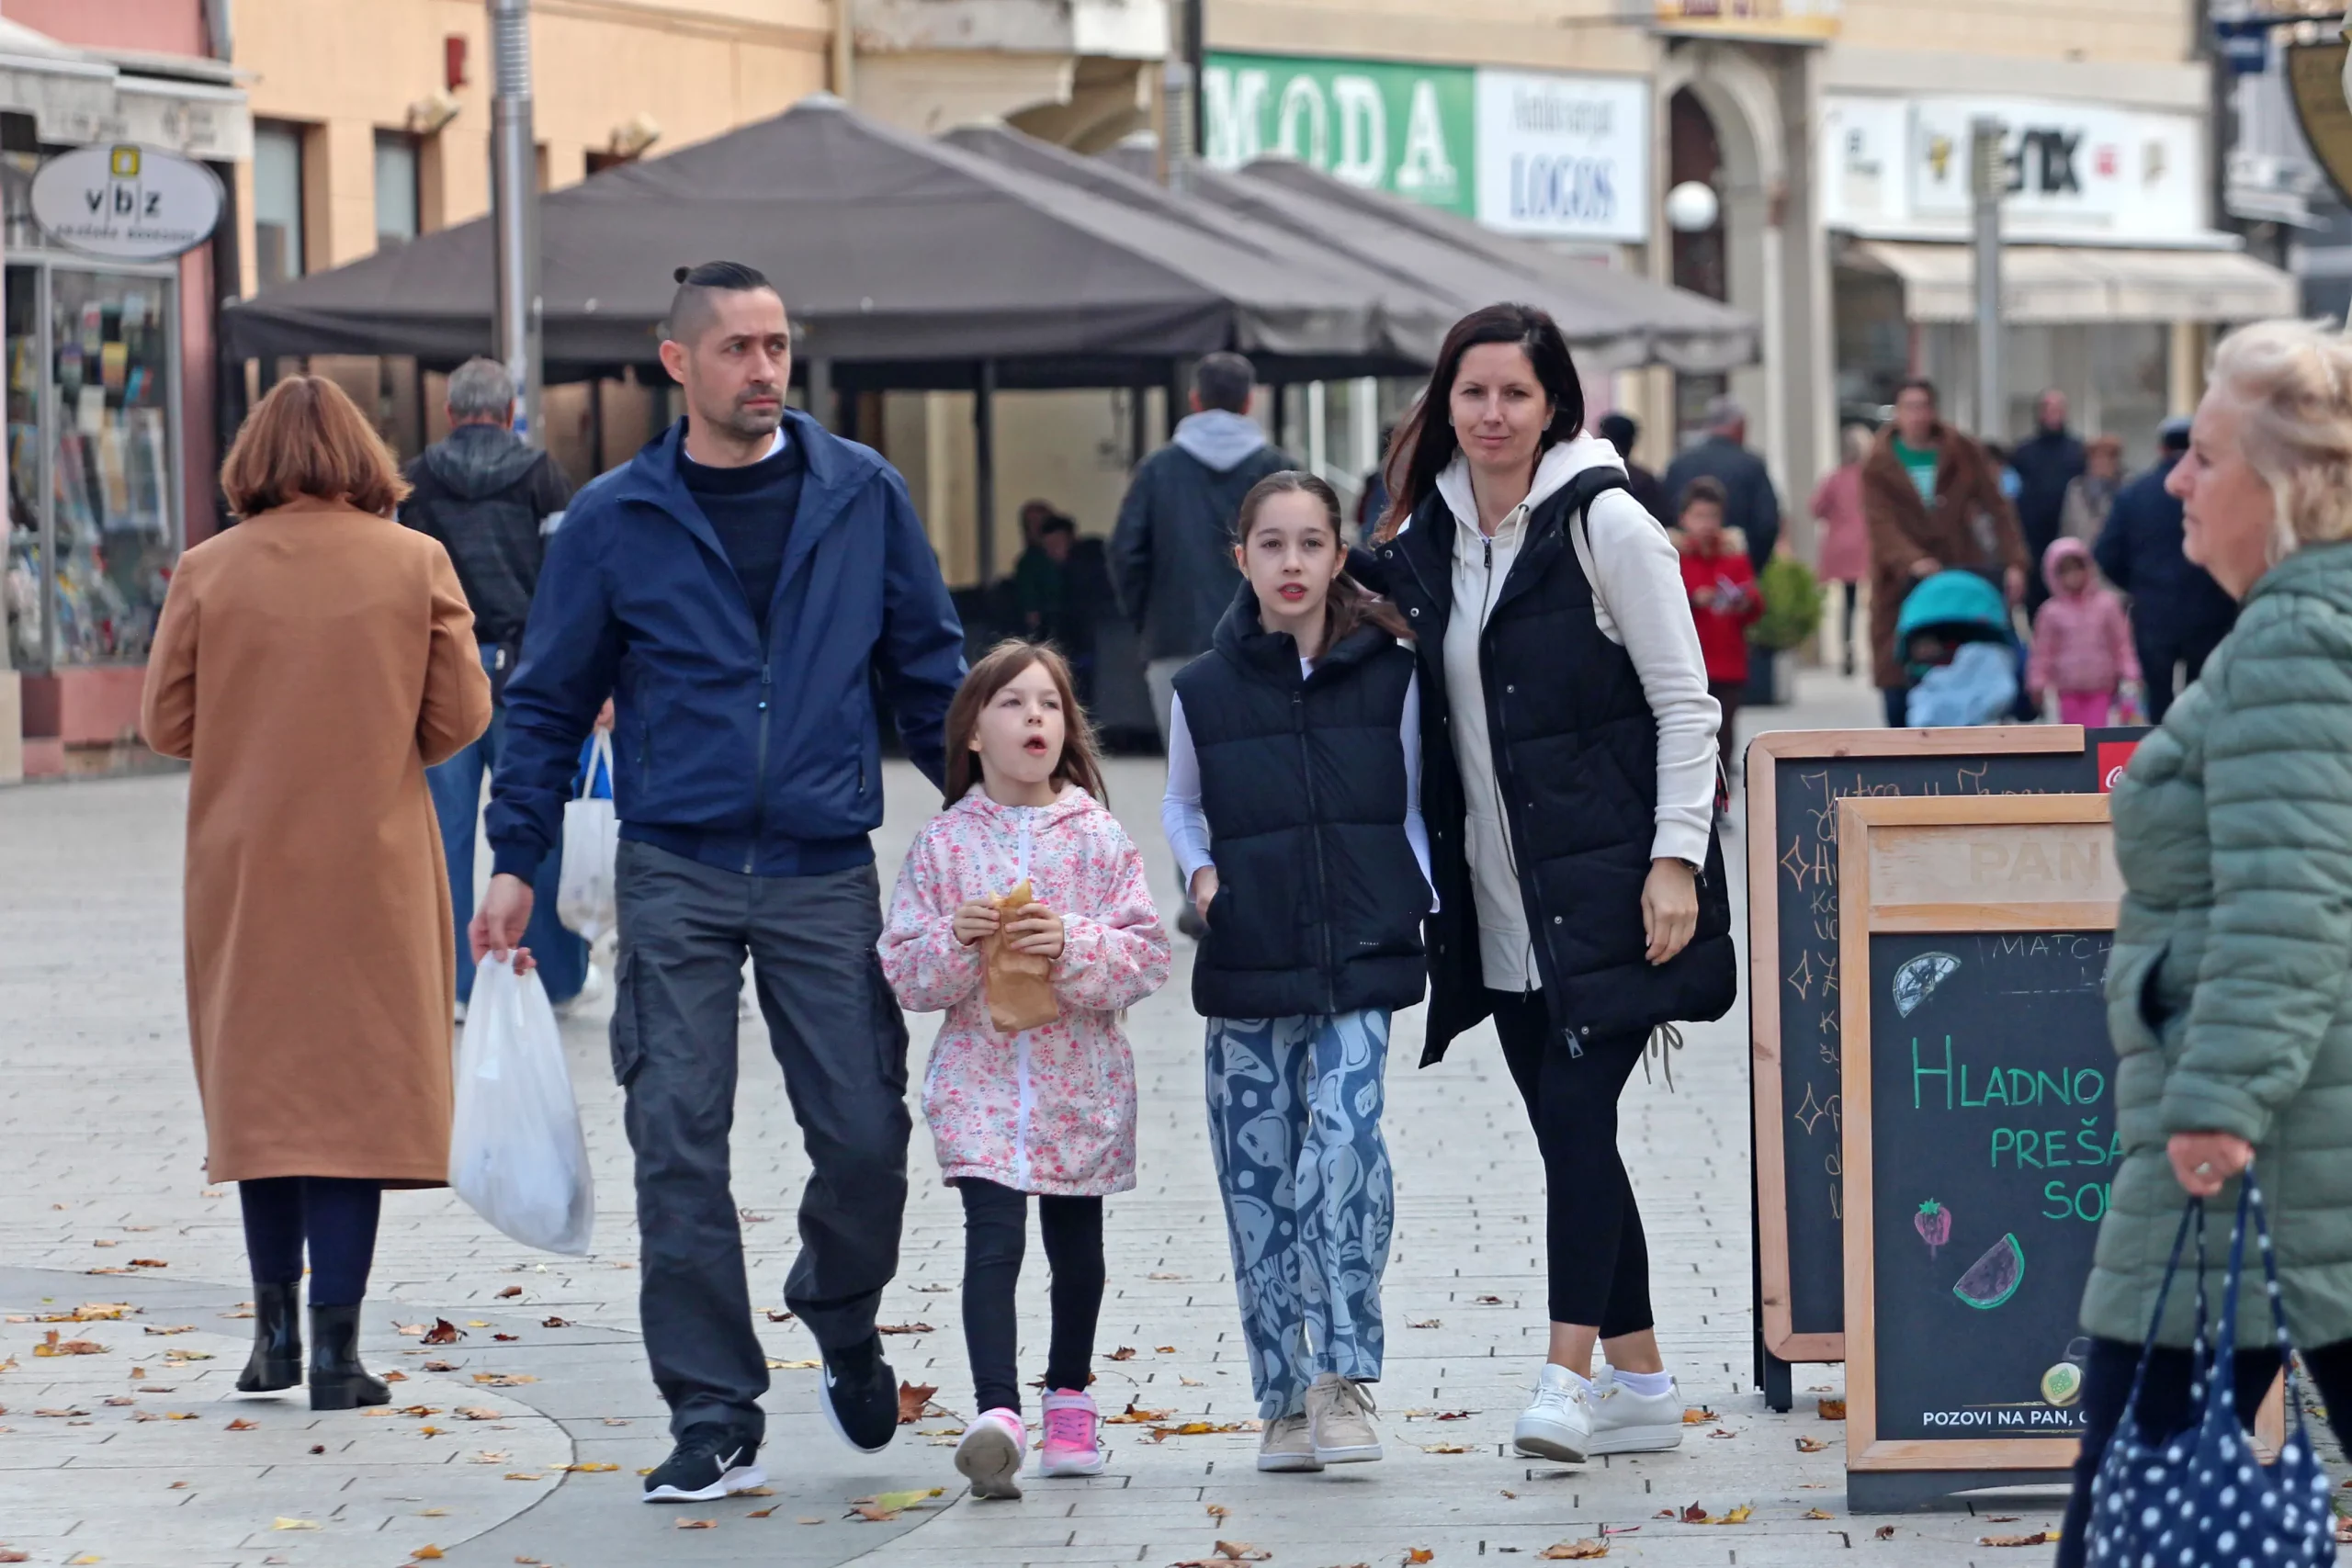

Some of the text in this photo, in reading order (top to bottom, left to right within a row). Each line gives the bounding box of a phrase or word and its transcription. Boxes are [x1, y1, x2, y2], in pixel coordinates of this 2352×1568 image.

[1202, 67, 1457, 189] MODA
[1511, 153, 1617, 222] LOGOS
[1969, 841, 2101, 882] PAN
[1912, 1034, 2105, 1110] HLADNO
[1923, 1411, 1992, 1426] POZOVI
[1997, 1411, 2025, 1425] NA
[2030, 1410, 2074, 1426] PAN,
